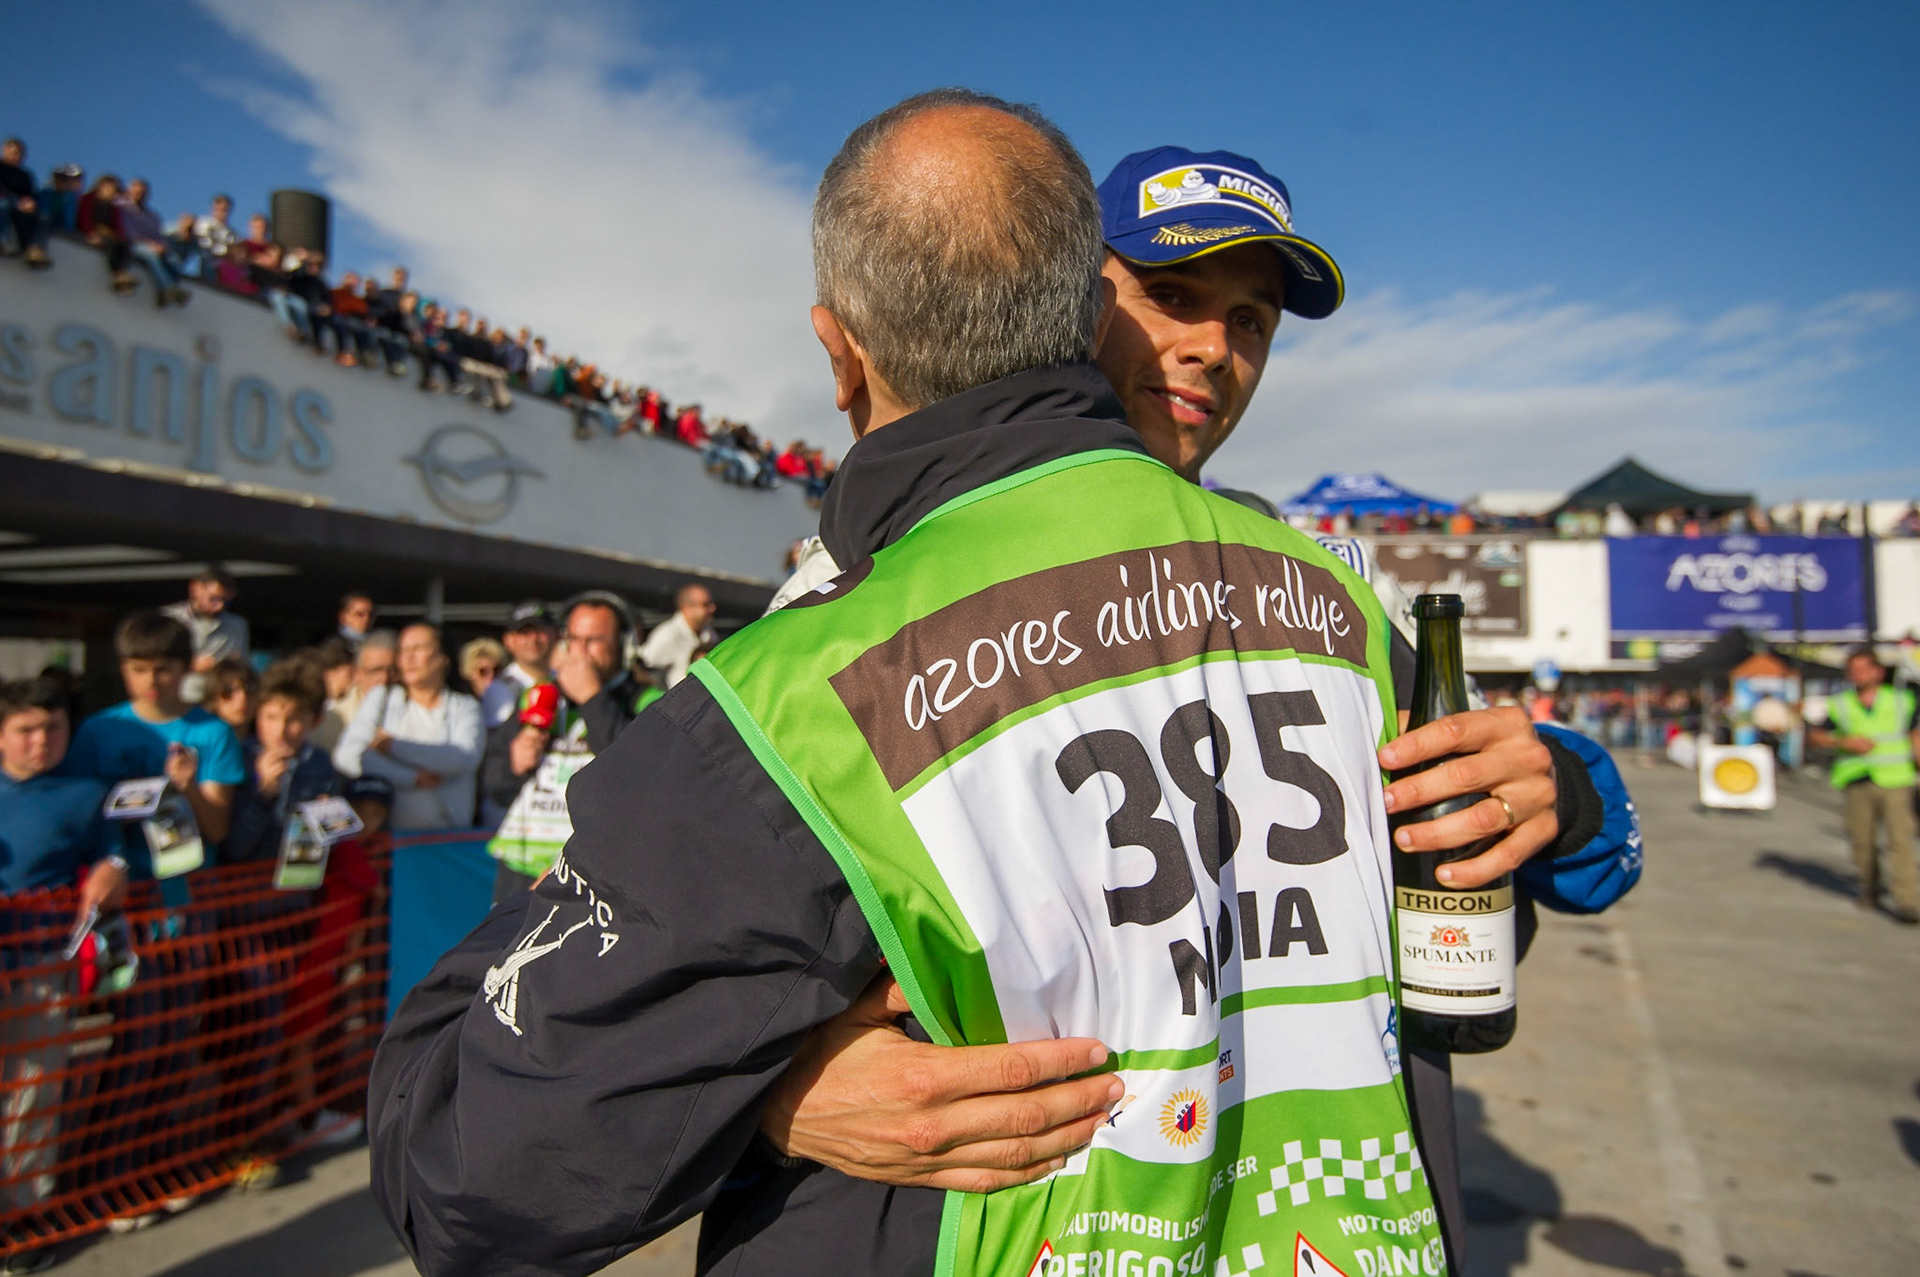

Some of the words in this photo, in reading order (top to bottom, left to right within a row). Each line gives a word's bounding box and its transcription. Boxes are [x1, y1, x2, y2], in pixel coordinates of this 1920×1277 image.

[51, 320, 335, 474] anjos
[1665, 552, 1828, 594] AZORES
[904, 610, 1083, 731] azores
[1096, 550, 1243, 648] airlines
[1255, 557, 1350, 656] rallye
[1054, 689, 1350, 928] 385
[1402, 891, 1492, 912] TRICON
[1403, 944, 1498, 964] SPUMANTE
[1227, 1155, 1259, 1183] SER
[1047, 1241, 1207, 1277] PERIGOSO
